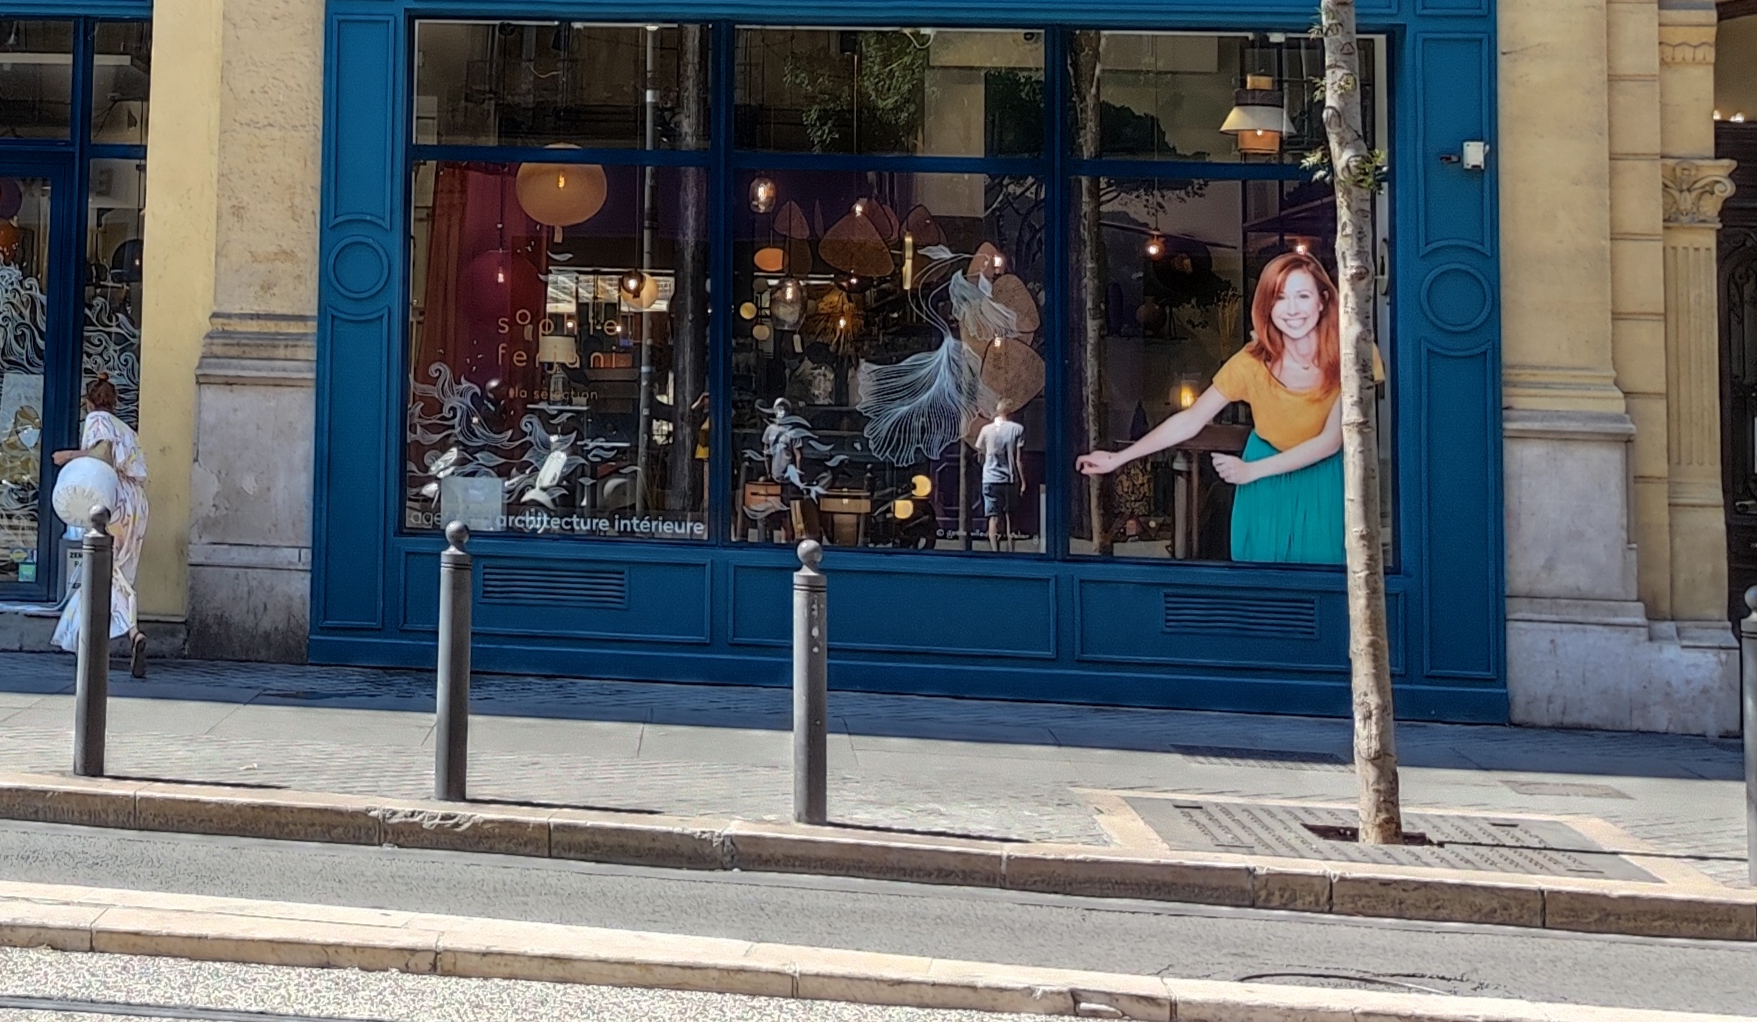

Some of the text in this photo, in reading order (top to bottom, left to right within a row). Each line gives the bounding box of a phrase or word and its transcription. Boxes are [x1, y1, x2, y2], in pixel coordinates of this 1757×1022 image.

[497, 309, 618, 345] sophie
[497, 343, 617, 374] ferjani
[515, 386, 598, 400] la séection
[614, 512, 705, 535] intérieure
